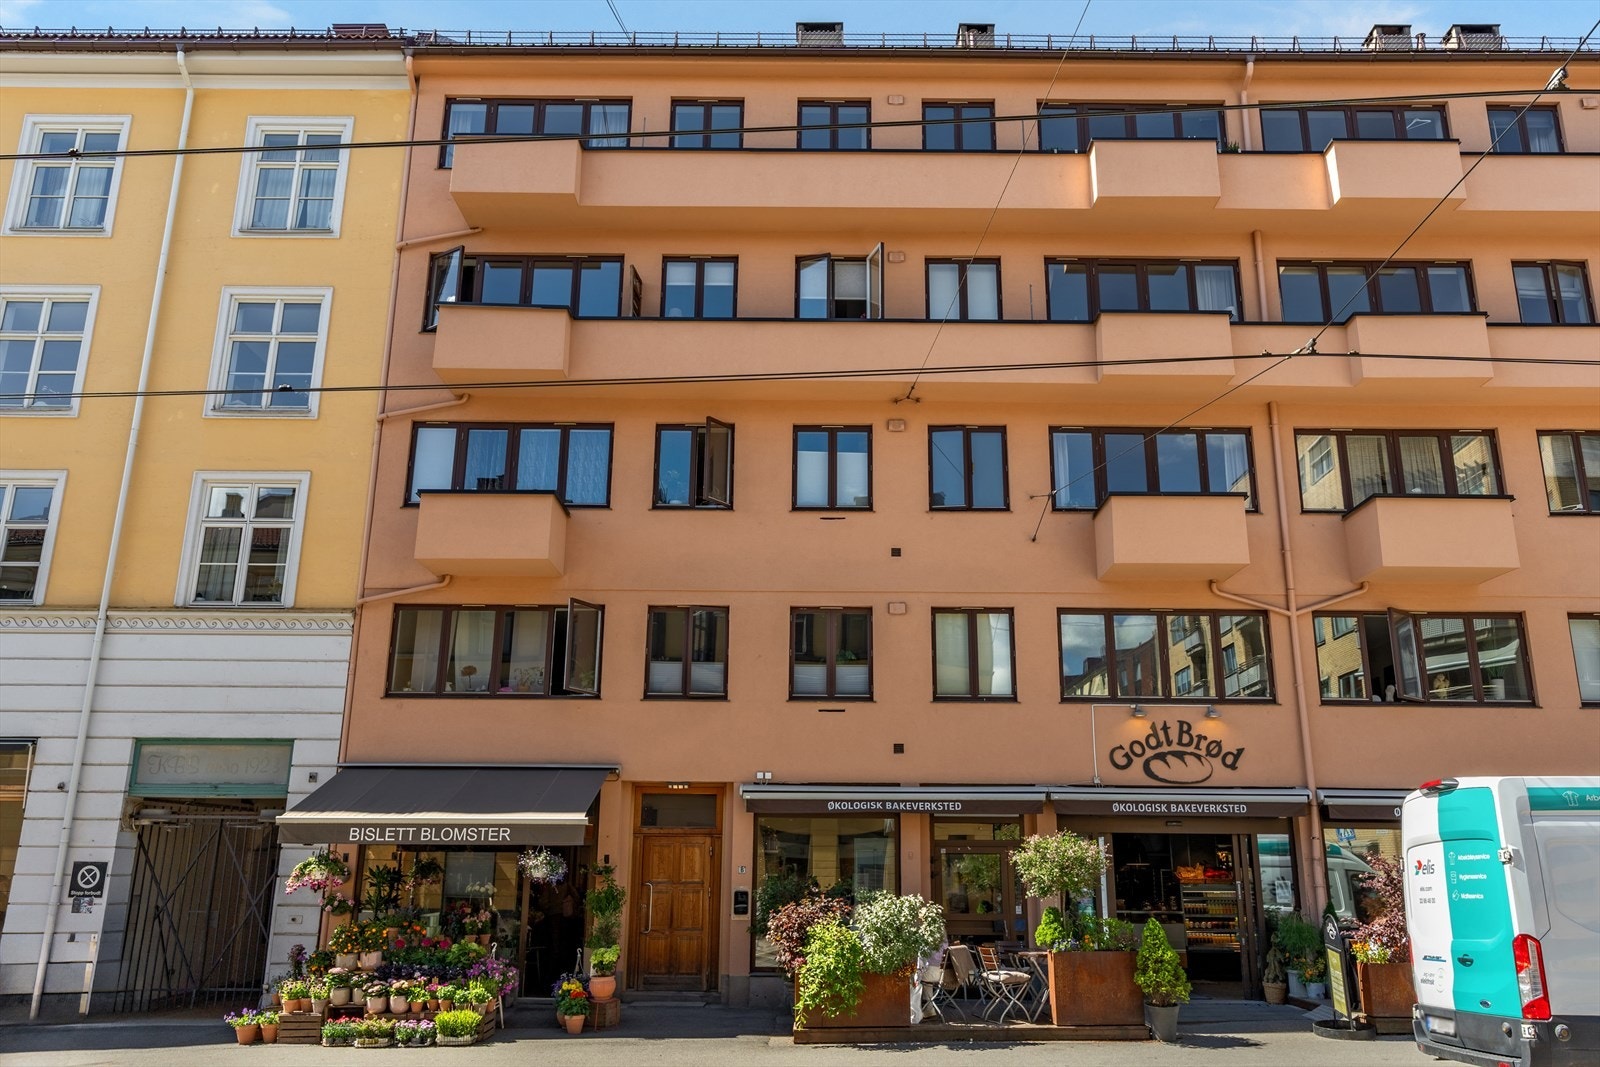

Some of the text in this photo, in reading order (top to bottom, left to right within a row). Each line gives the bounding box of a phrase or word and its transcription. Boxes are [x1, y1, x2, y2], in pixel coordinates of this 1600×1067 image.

[1109, 720, 1245, 771] Godt Brød
[827, 801, 962, 811] ØKOLOGISK BAKEVERKSTED
[1112, 803, 1247, 813] ØKOLOGISK BAKEVERKSTED
[349, 827, 511, 841] BISLETT BLOMSTER
[1421, 859, 1435, 875] elis
